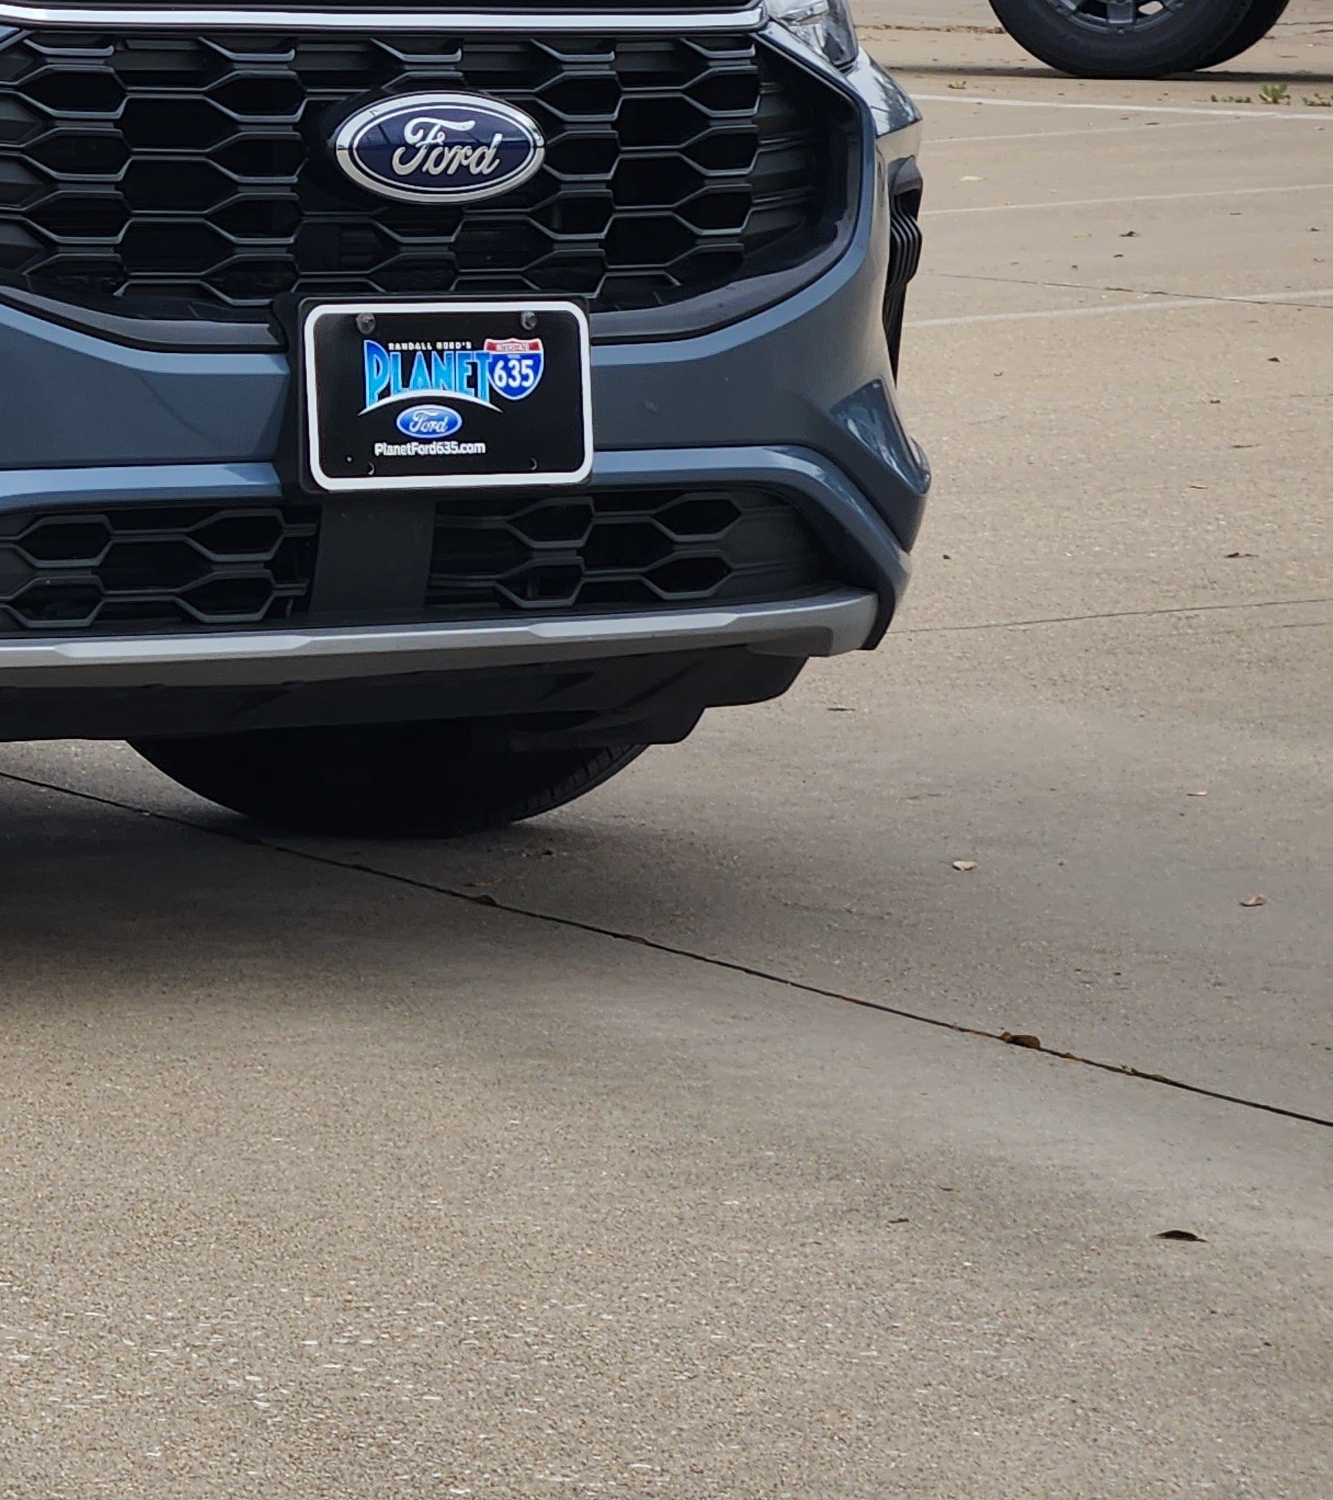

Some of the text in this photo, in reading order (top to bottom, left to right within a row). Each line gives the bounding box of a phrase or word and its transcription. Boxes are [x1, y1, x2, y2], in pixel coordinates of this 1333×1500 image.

[392, 117, 502, 175] Ford
[364, 340, 533, 407] PLANET 635
[409, 410, 449, 432] Ford
[374, 441, 486, 456] PlanetFord635.com
